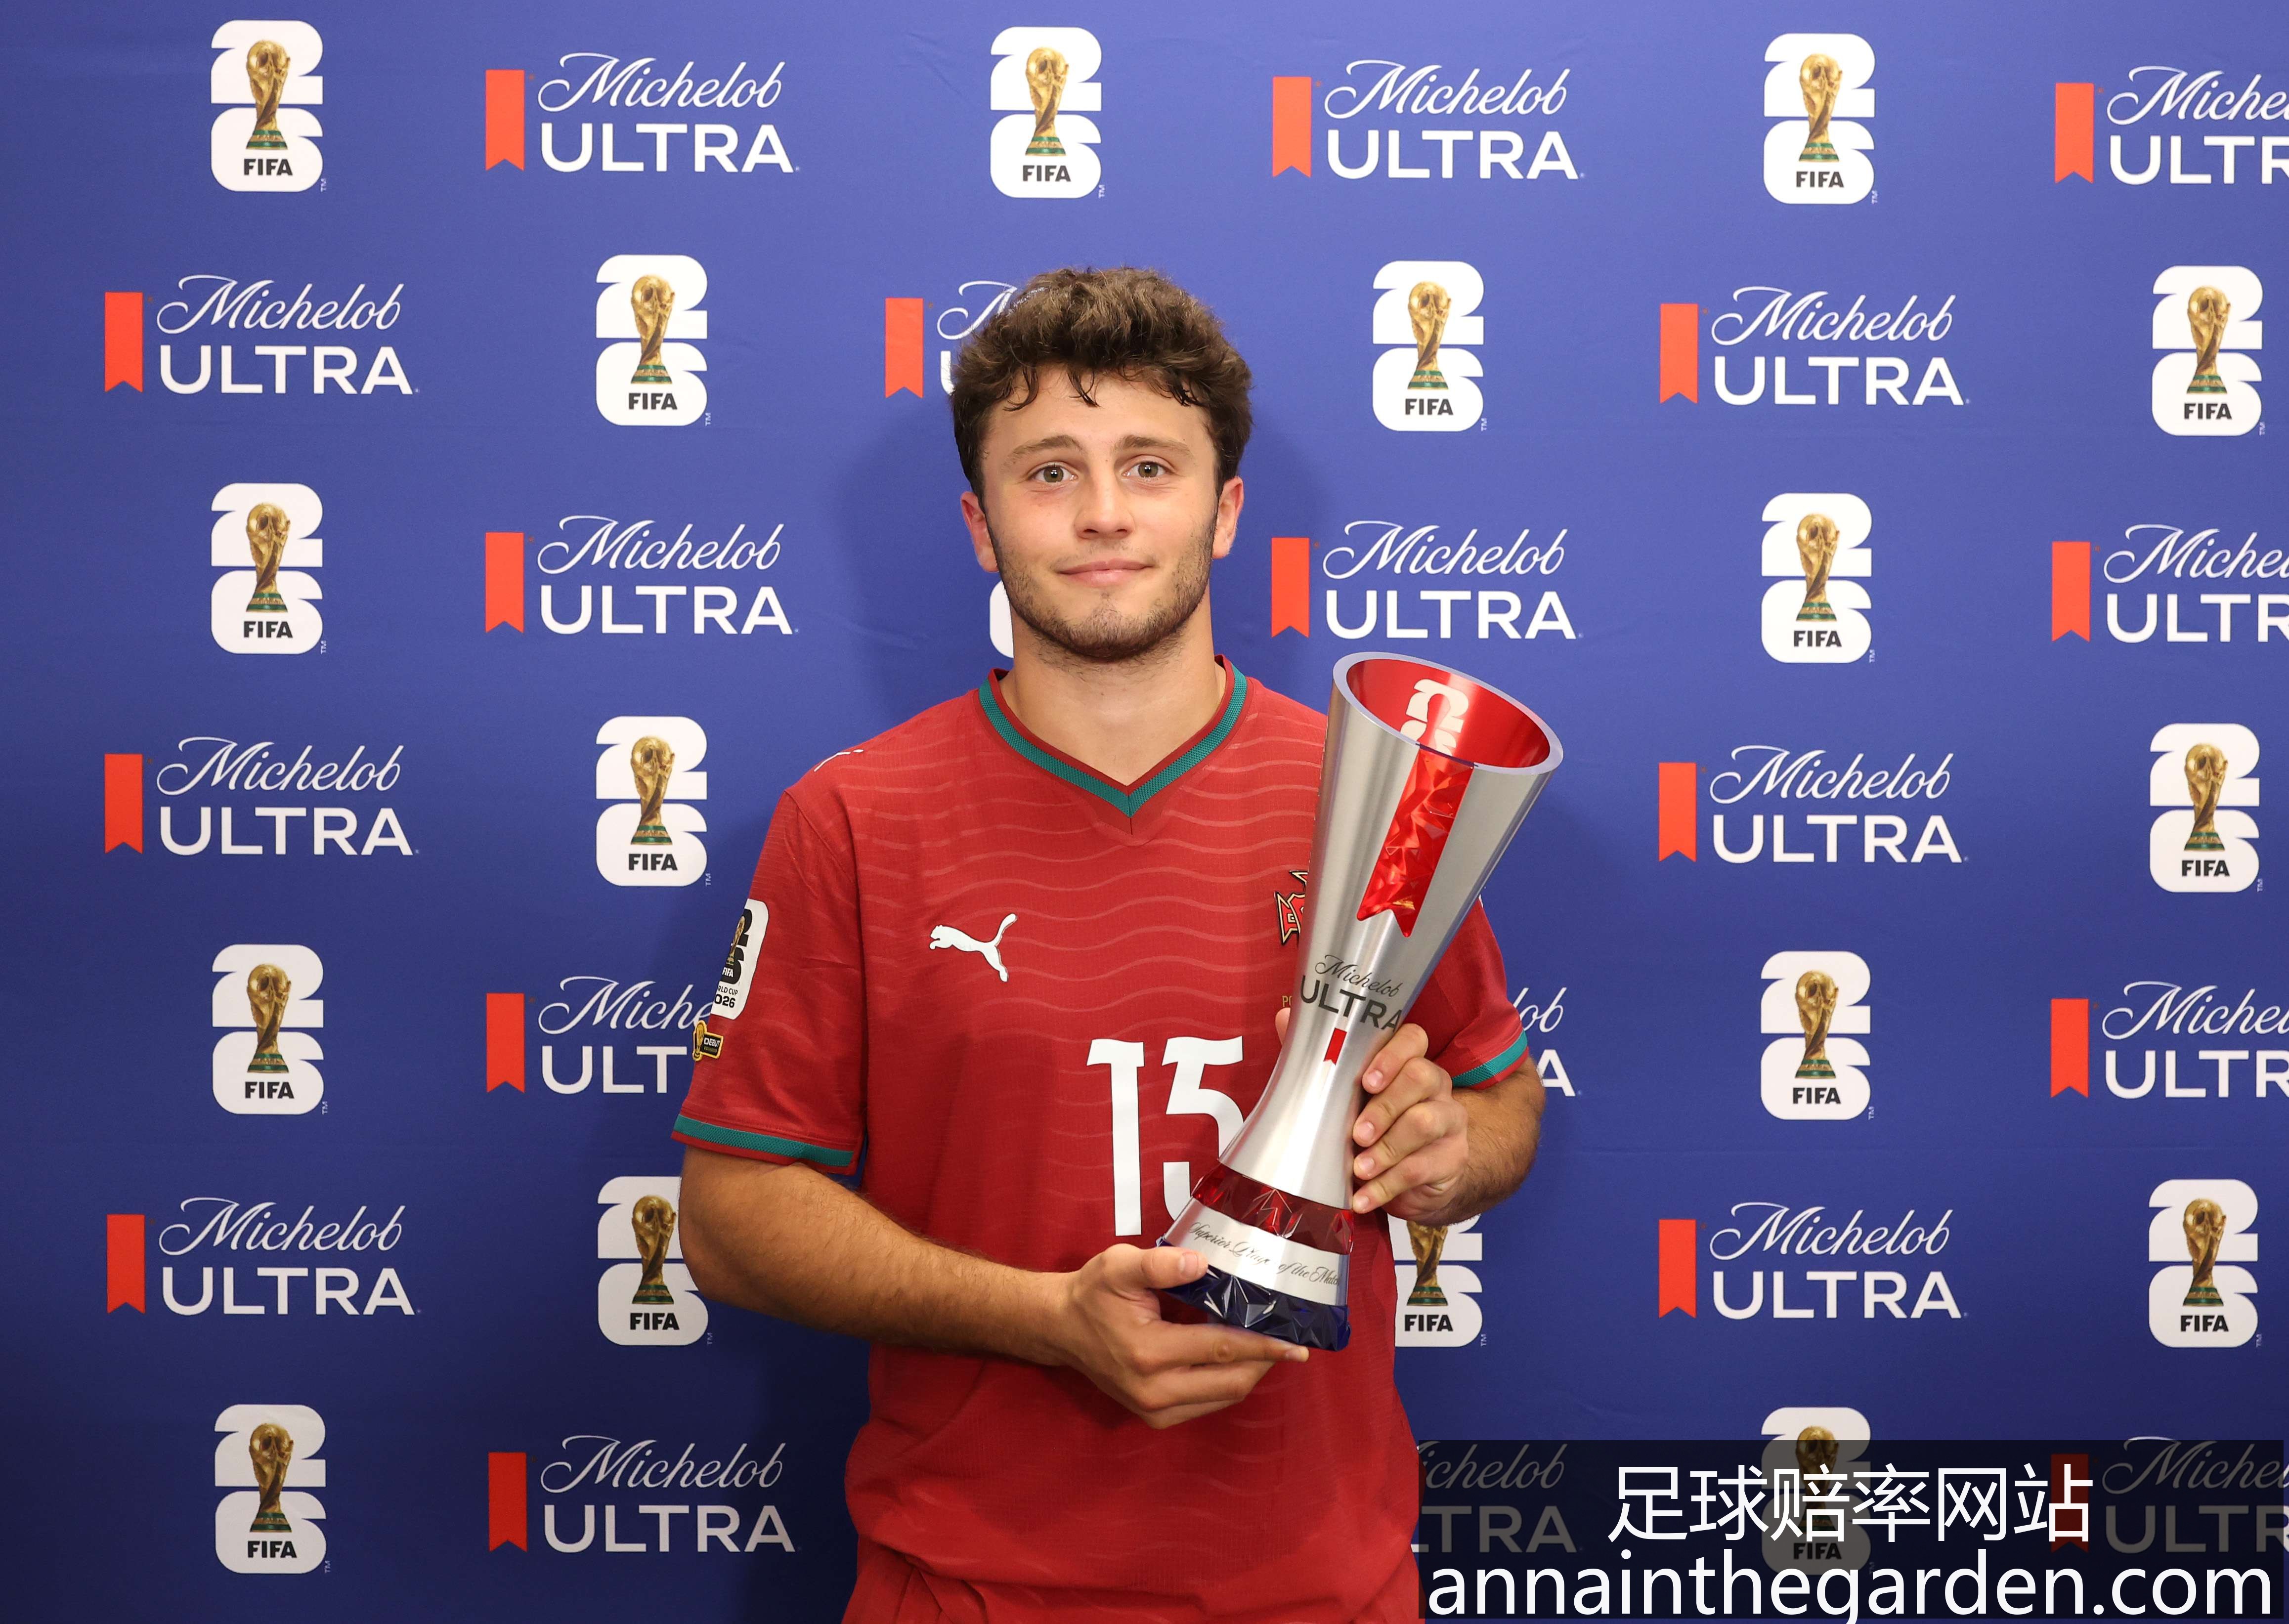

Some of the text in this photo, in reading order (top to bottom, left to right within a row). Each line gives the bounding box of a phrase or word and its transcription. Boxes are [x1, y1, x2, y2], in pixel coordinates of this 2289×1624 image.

[538, 52, 785, 112] Michelob
[1325, 59, 1570, 119] Michelob
[2107, 66, 2289, 125] Miche
[244, 159, 292, 175] FIFA
[541, 123, 794, 173] ULTRA
[1327, 129, 1578, 180] ULTRA
[1023, 166, 1071, 182] FIFA
[1796, 171, 1844, 188] FIFA
[157, 275, 404, 334] Michelob
[1712, 286, 1956, 345] Michelob
[160, 344, 413, 394] ULTRA
[1714, 356, 1964, 406] ULTRA
[629, 393, 678, 410] FIFA
[1405, 399, 1454, 415] FIFA
[2184, 403, 2232, 420] FIFA
[537, 515, 783, 574] Michelob
[1323, 520, 1568, 579] Michelob
[2104, 524, 2289, 583] Miche
[244, 622, 292, 638] FIFA
[541, 585, 793, 635] ULTRA
[1326, 590, 1576, 640] ULTRA
[1794, 631, 1842, 647] FIFA
[157, 737, 404, 795] Michelob
[1710, 745, 1953, 804] Michelob
[161, 807, 413, 855] ULTRA
[1713, 814, 1962, 863] ULTRA
[629, 854, 678, 871] FIFA
[2182, 860, 2230, 876] FIFA
[722, 967, 734, 978] FIFA
[1315, 955, 1403, 997] Michelob
[1300, 975, 1402, 1033] ULTRA
[703, 1037, 721, 1048] DEBUT
[245, 1082, 294, 1098] FIFA
[1793, 1088, 1841, 1104] FIFA
[1086, 1035, 1244, 1237] 15
[159, 1197, 405, 1255] Michelob
[1710, 1202, 1953, 1260] Michelob
[163, 1267, 414, 1315] ULTRA
[1713, 1271, 1961, 1320] ULTRA
[630, 1313, 679, 1330] FIFA
[1405, 1315, 1453, 1331] FIFA
[2181, 1315, 2229, 1332] FIFA
[541, 1436, 785, 1493] Michelob
[1417, 1441, 1567, 1489] chelob
[248, 1541, 297, 1558] FIFA
[545, 1505, 795, 1552] ULTRA
[1410, 1505, 1577, 1553] TRA
[1793, 1543, 1842, 1559] FIFA
